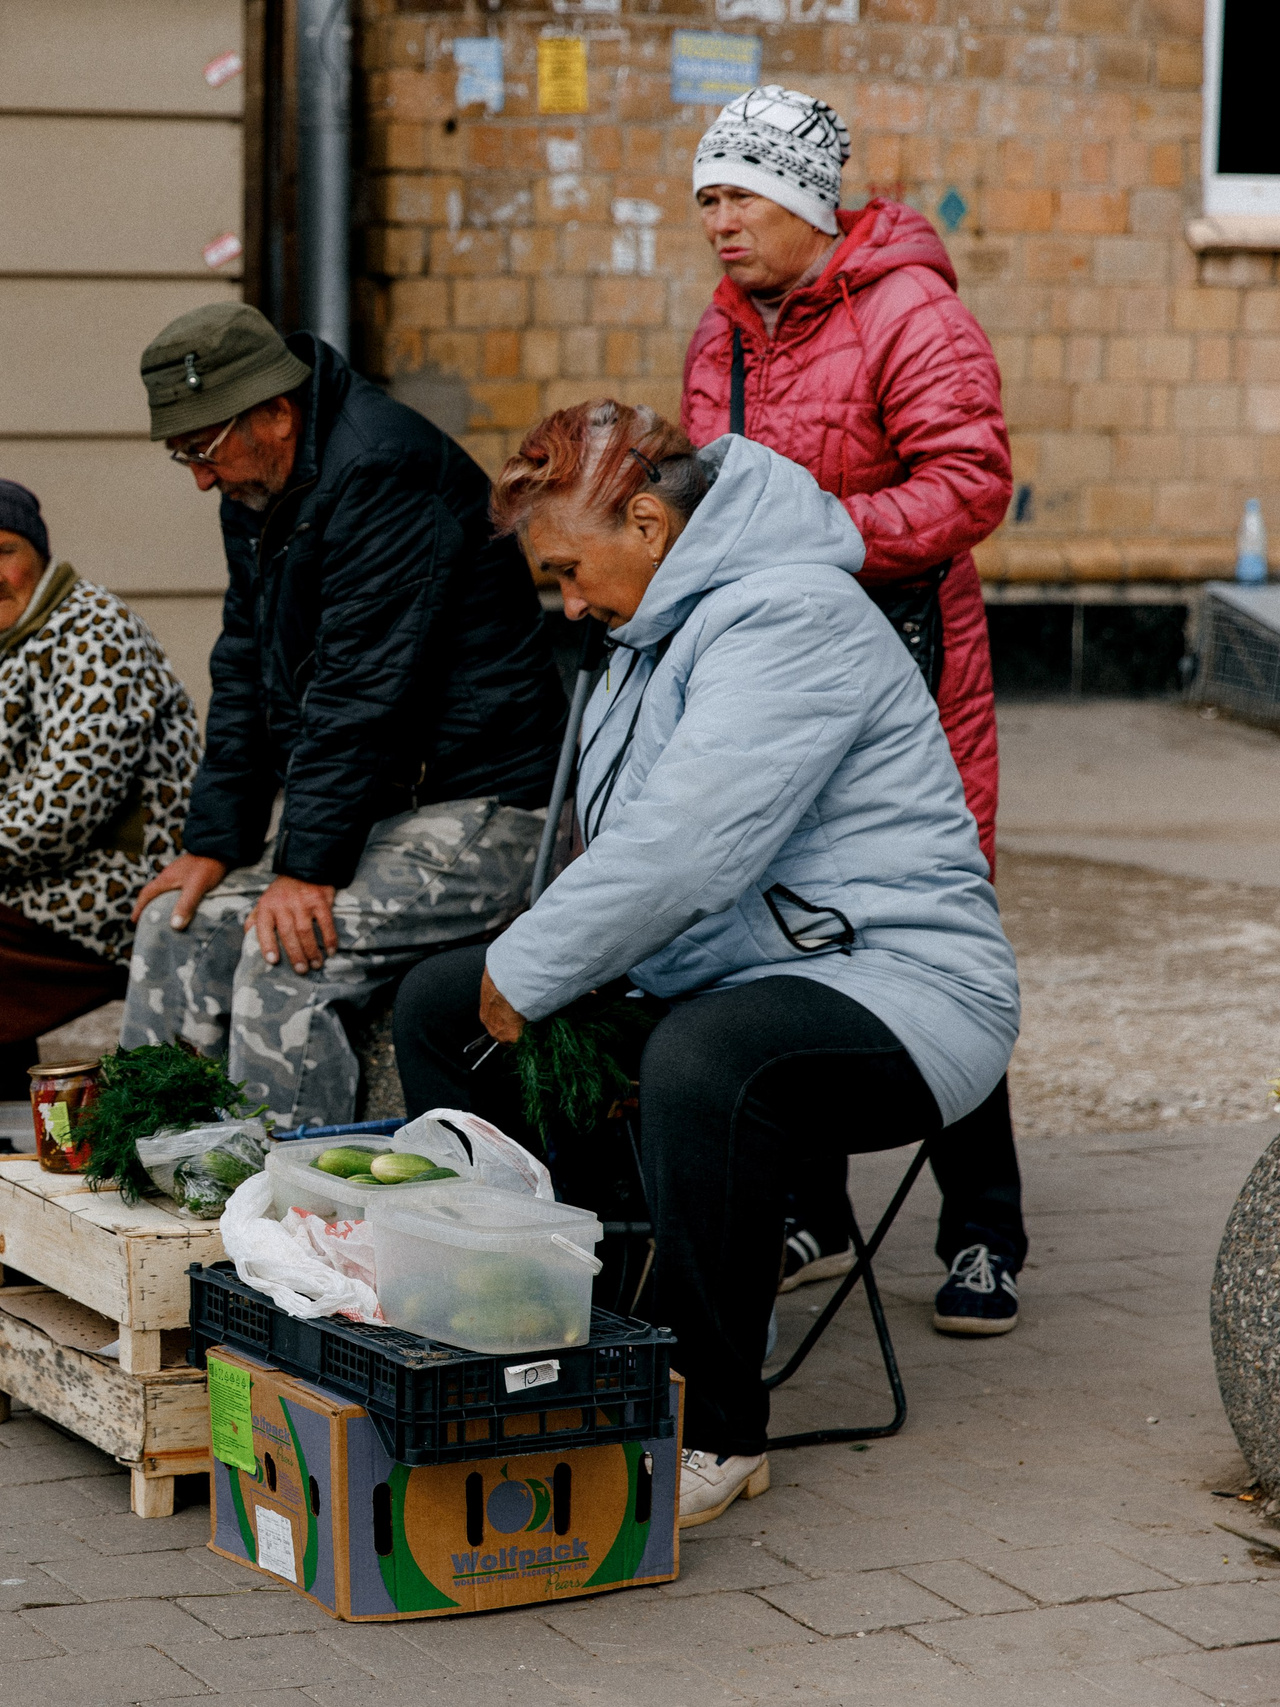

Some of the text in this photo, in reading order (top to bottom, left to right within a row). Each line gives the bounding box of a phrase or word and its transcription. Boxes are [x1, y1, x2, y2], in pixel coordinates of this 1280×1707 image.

[251, 1413, 291, 1443] olfpack
[451, 1537, 590, 1574] Wolfpack
[544, 1571, 582, 1593] Pears
